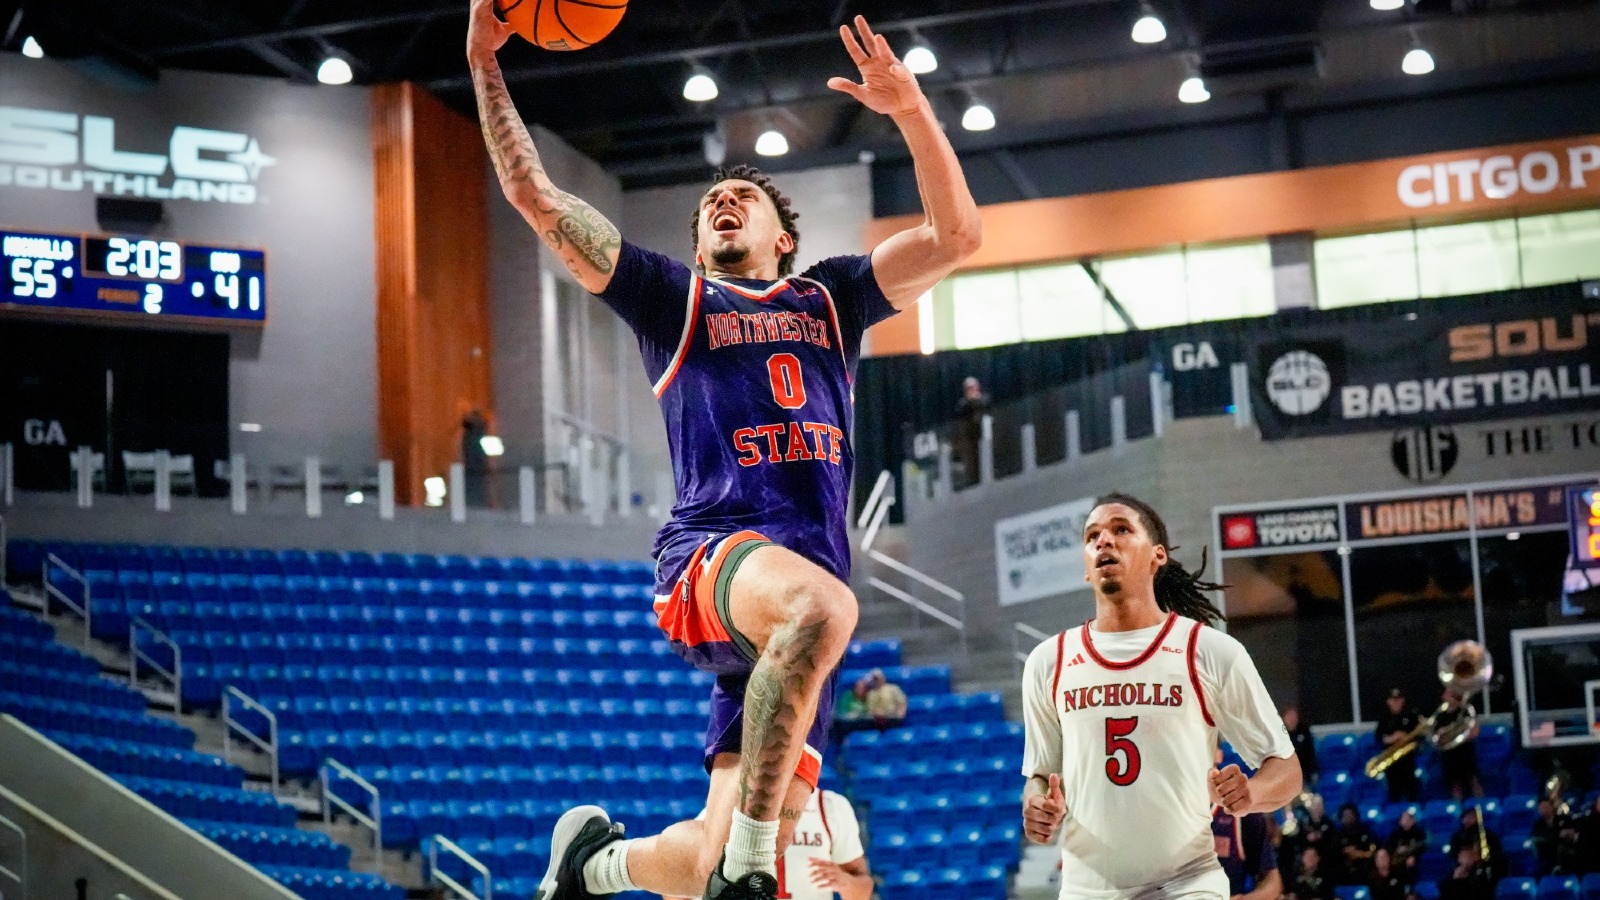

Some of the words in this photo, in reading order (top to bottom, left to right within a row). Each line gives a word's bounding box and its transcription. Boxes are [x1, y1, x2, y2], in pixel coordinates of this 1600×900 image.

[0, 106, 250, 183] SLC
[1397, 151, 1560, 208] CITGO
[11, 257, 57, 298] 55
[106, 237, 182, 280] 2:03
[144, 283, 163, 314] 2
[214, 273, 260, 311] 41
[1172, 342, 1219, 371] GA
[1449, 313, 1600, 363] SOU
[766, 353, 807, 409] 0
[1341, 362, 1600, 420] BASKETBALL
[23, 418, 67, 447] GA
[732, 421, 843, 467] STATE
[1478, 425, 1552, 456] THE
[1258, 521, 1338, 546] TOYOTA
[1361, 491, 1536, 538] LOUISIANA'S
[1162, 646, 1183, 654] SLC
[1064, 683, 1183, 713] NICHOLLS
[1105, 716, 1141, 787] 5
